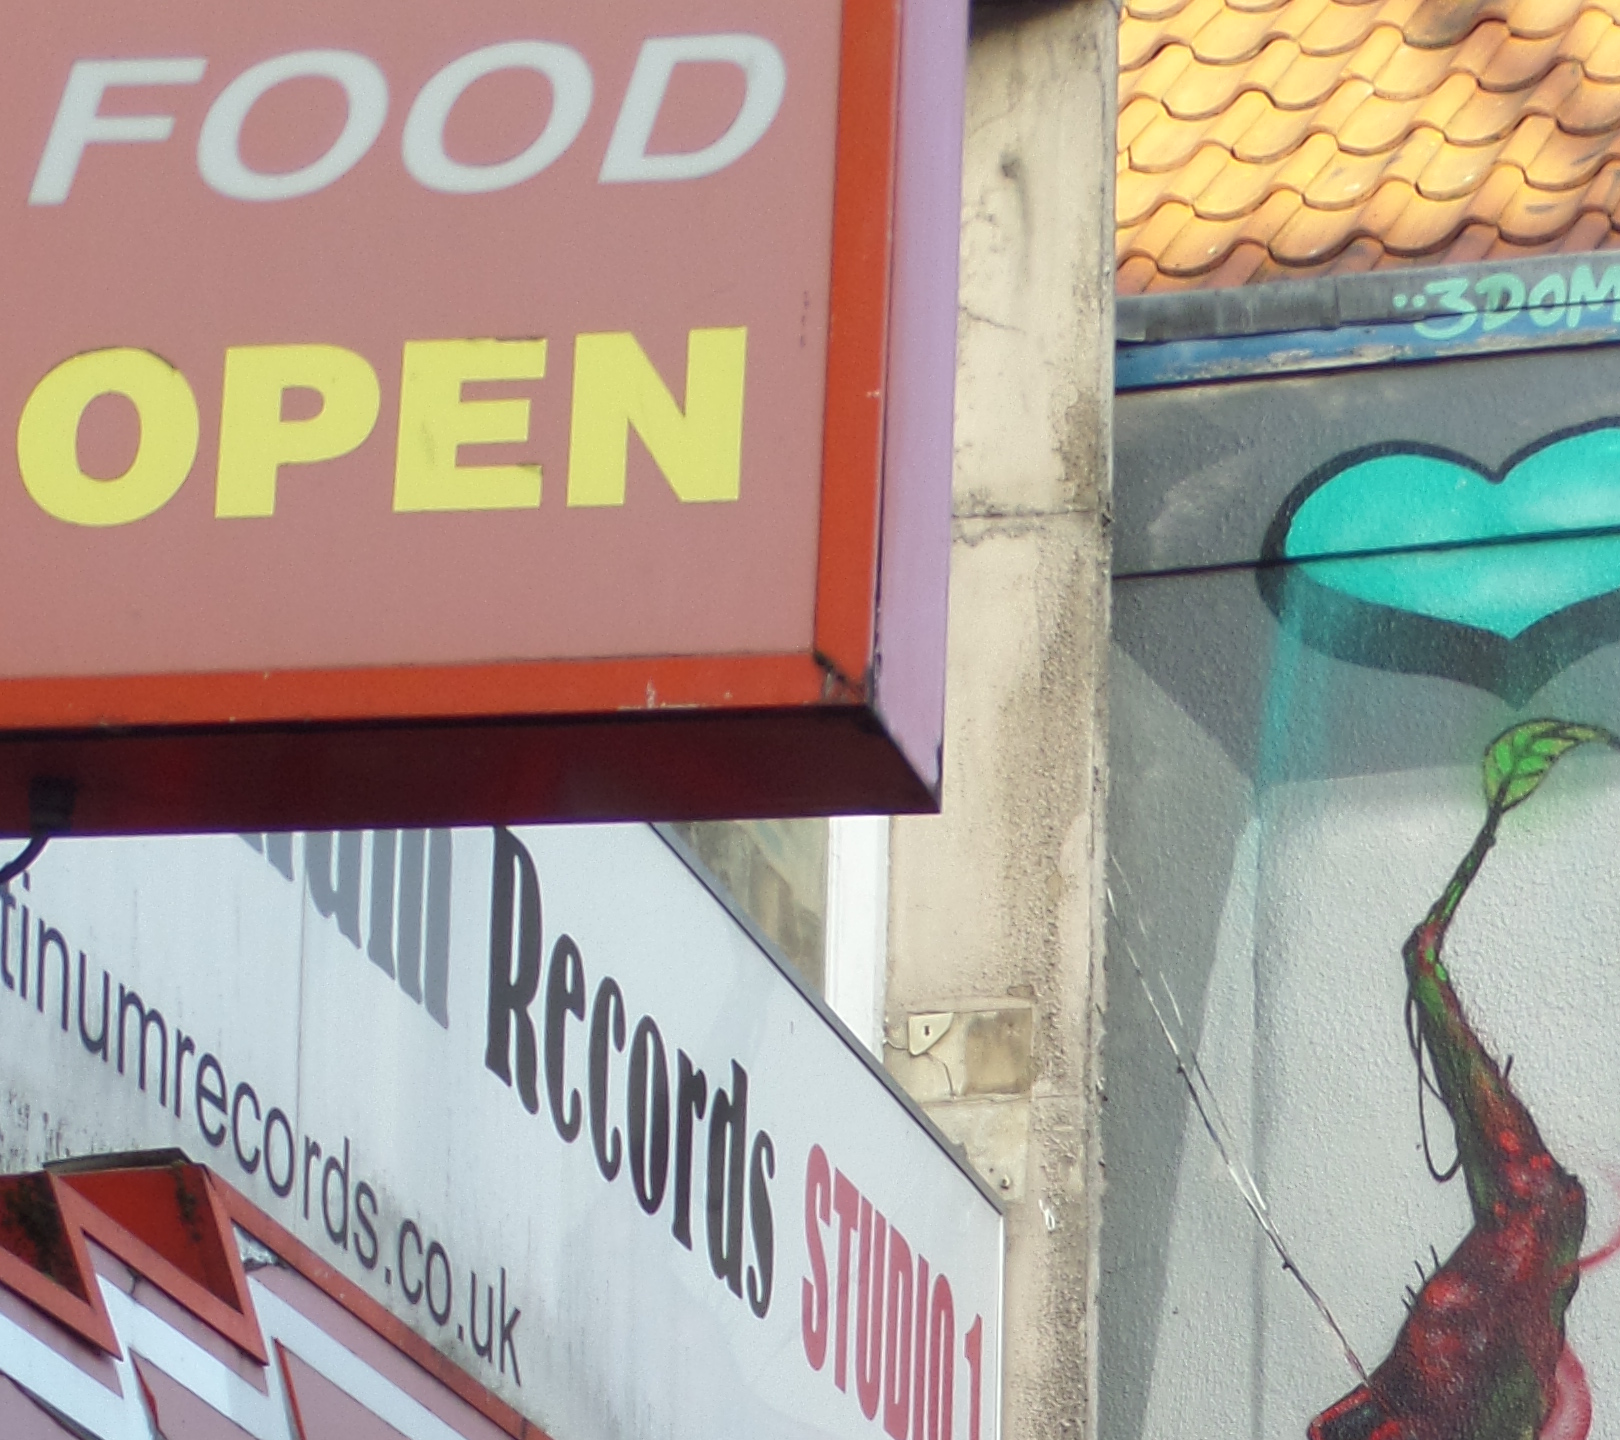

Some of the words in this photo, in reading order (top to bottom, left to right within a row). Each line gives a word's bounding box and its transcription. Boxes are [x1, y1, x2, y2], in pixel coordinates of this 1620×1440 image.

[28, 33, 786, 206] FOOD
[17, 326, 748, 528] OPEN
[484, 826, 777, 1319] Records
